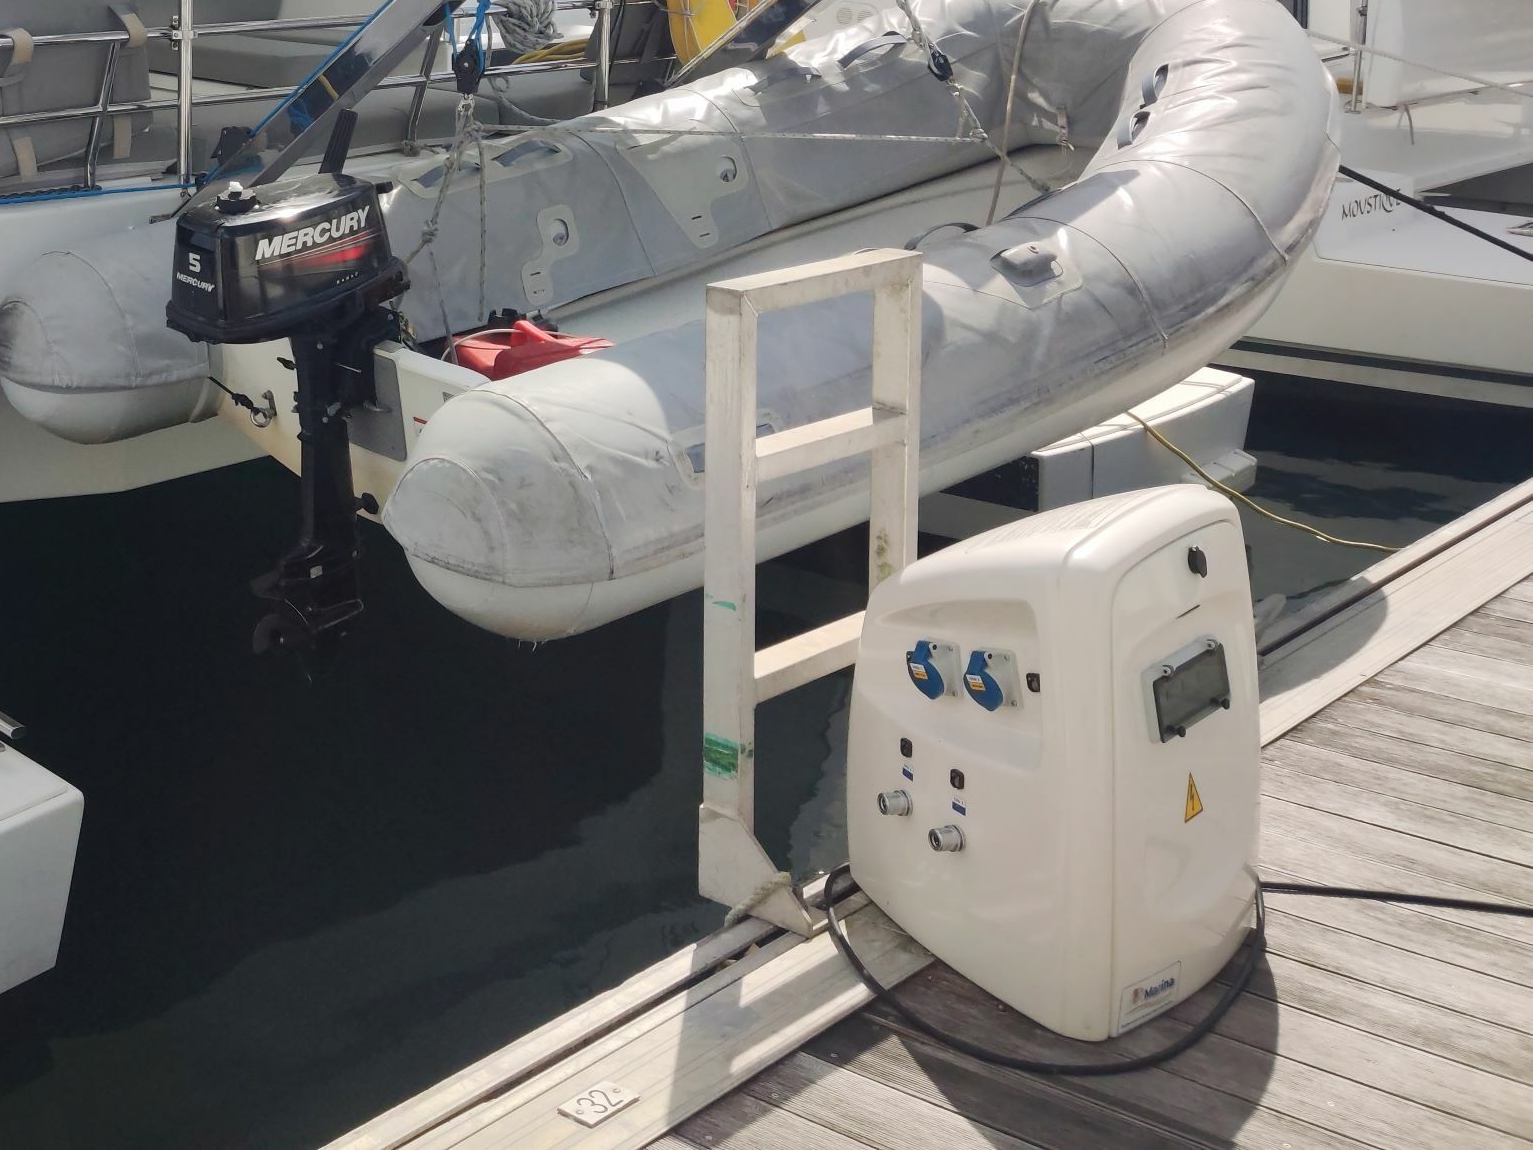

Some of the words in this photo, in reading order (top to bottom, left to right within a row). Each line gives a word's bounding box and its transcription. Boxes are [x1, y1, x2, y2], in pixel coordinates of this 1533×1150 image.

[254, 205, 371, 261] MERCURY
[188, 252, 202, 273] 5
[176, 271, 216, 293] MERCURY
[576, 1089, 625, 1115] 32
